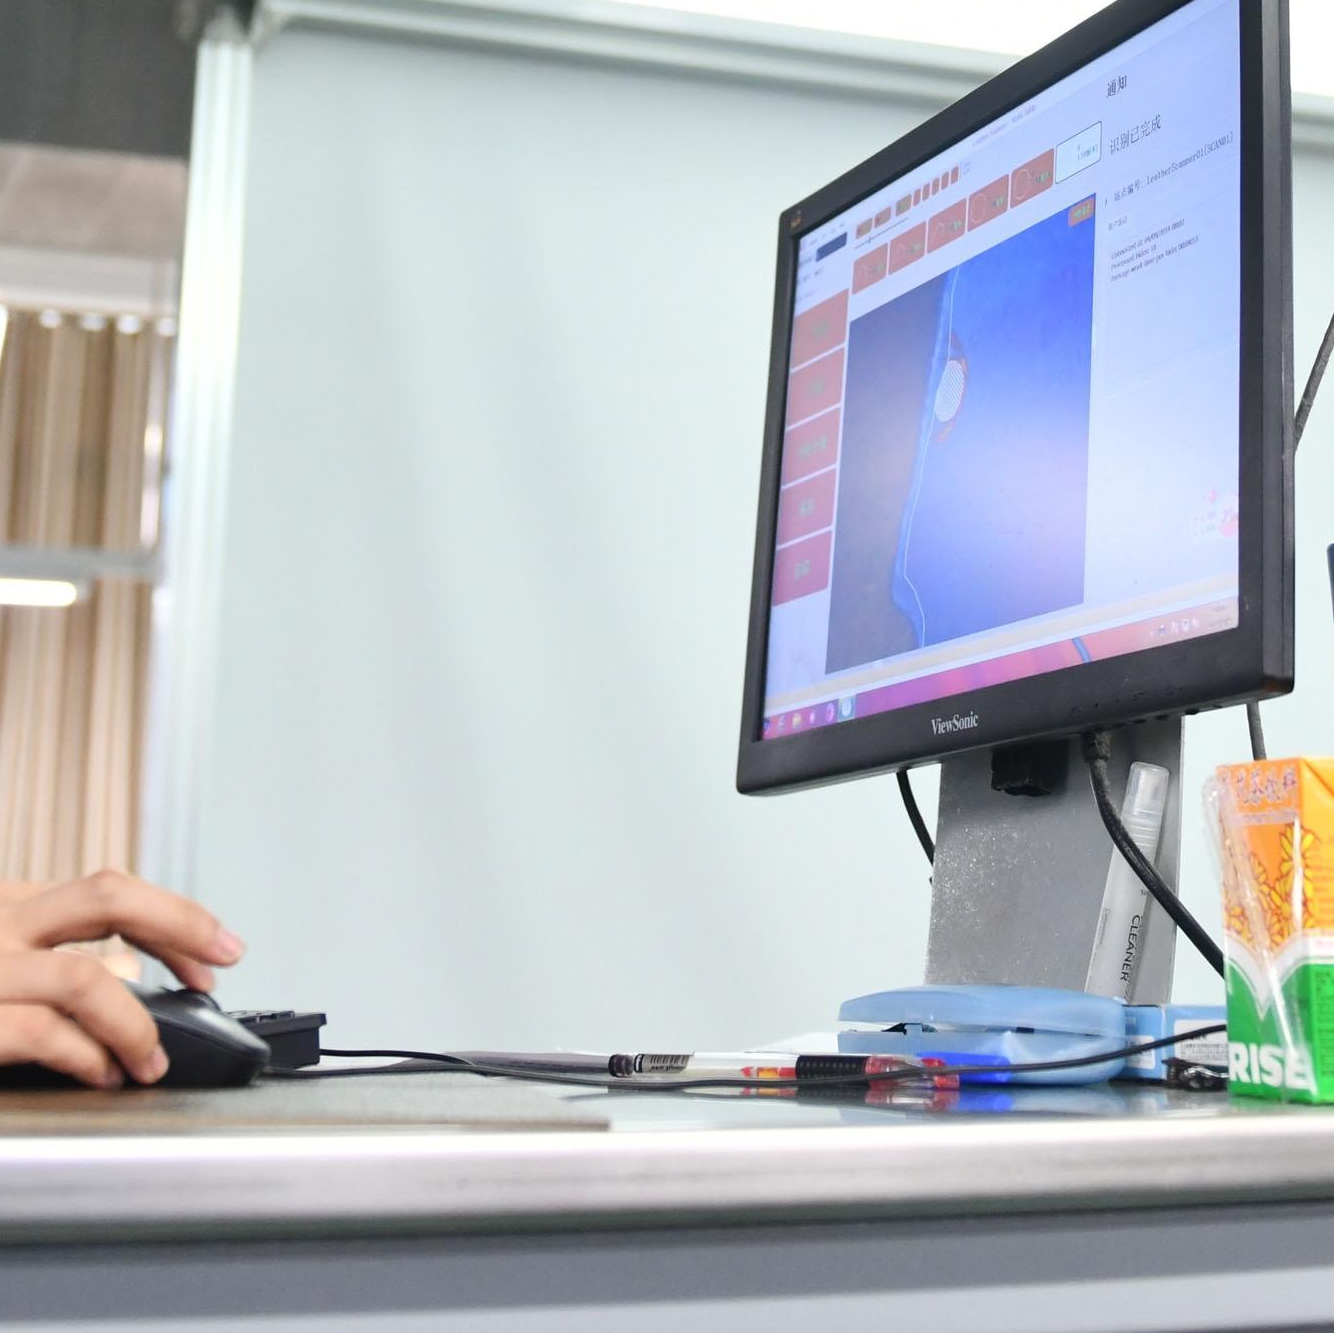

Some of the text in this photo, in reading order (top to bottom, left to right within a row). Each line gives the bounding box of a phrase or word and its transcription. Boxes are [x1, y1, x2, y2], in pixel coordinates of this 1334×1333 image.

[1106, 74, 1128, 98] 通知
[1109, 113, 1162, 155] 识别已完成
[930, 710, 979, 736] ViewSonic
[1119, 914, 1142, 982] CLEANER
